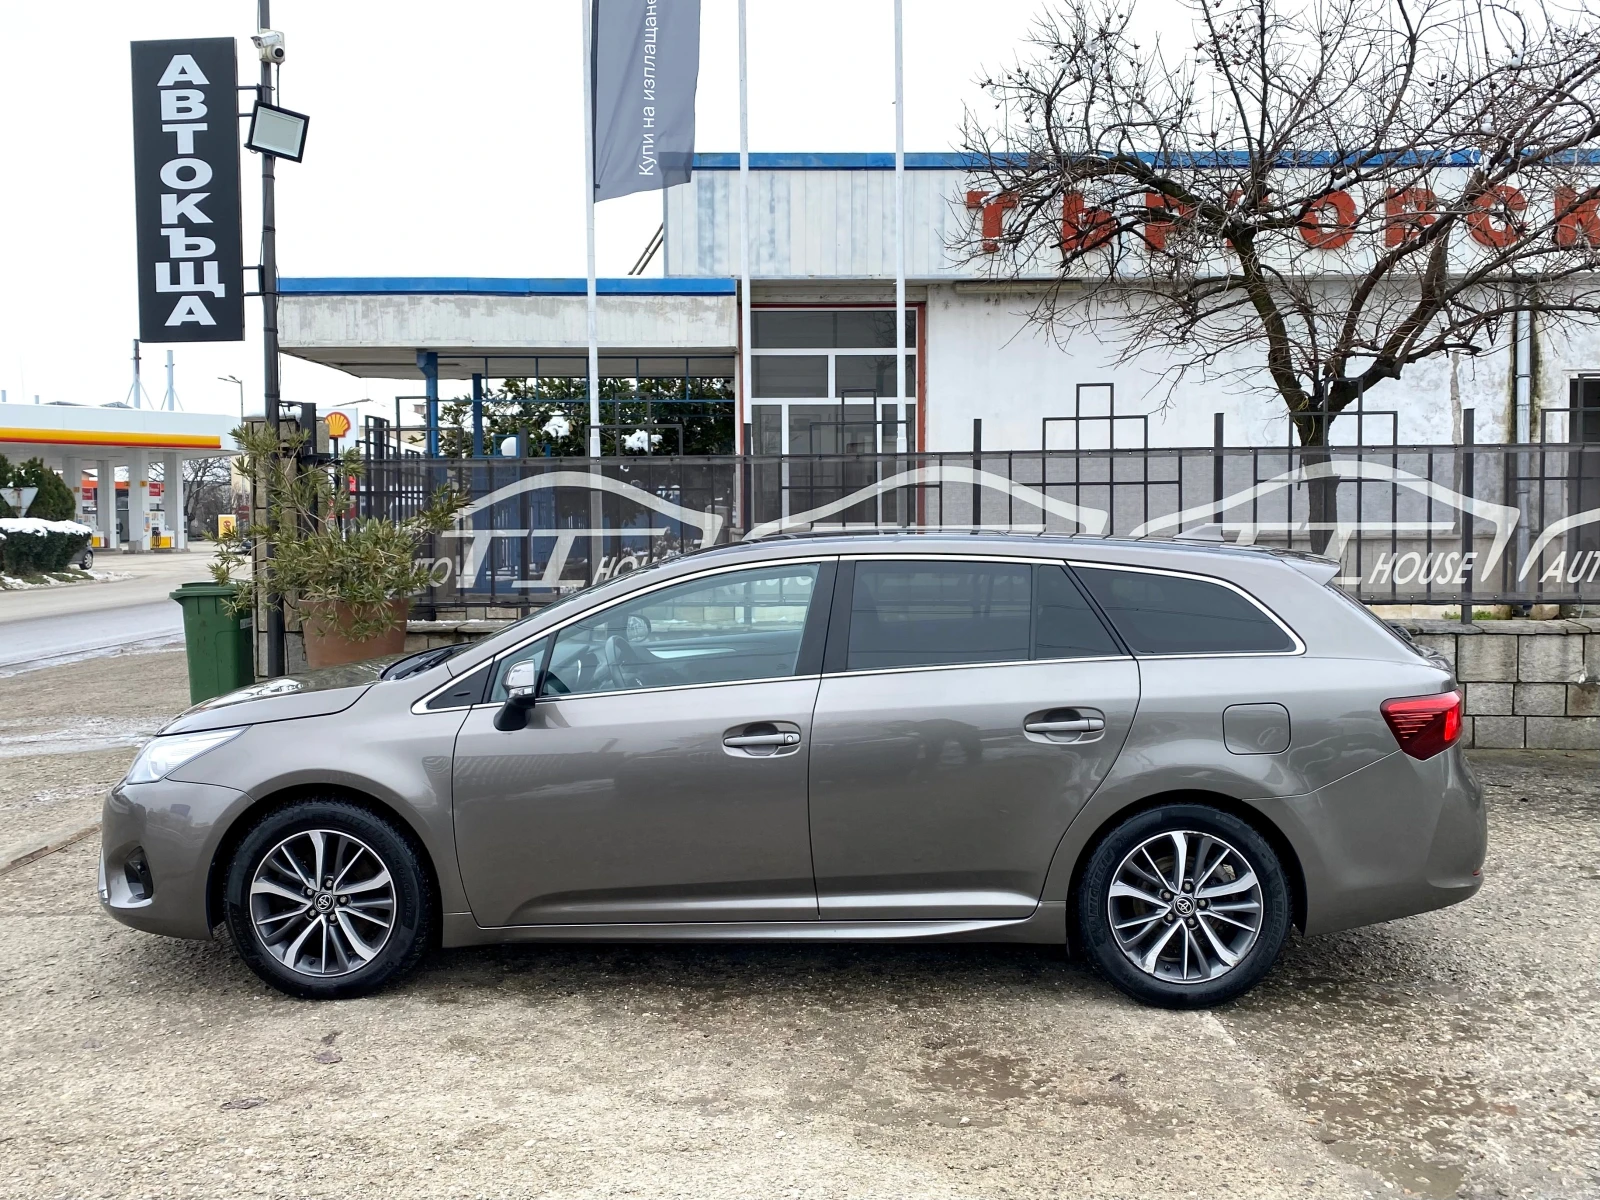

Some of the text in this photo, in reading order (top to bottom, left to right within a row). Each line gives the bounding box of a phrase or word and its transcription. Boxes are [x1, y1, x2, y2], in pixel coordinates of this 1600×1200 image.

[643, 106, 655, 128] на
[639, 133, 657, 176] Купи
[155, 54, 225, 326] АВТОКЪЩА
[1368, 551, 1478, 585] HOUSE
